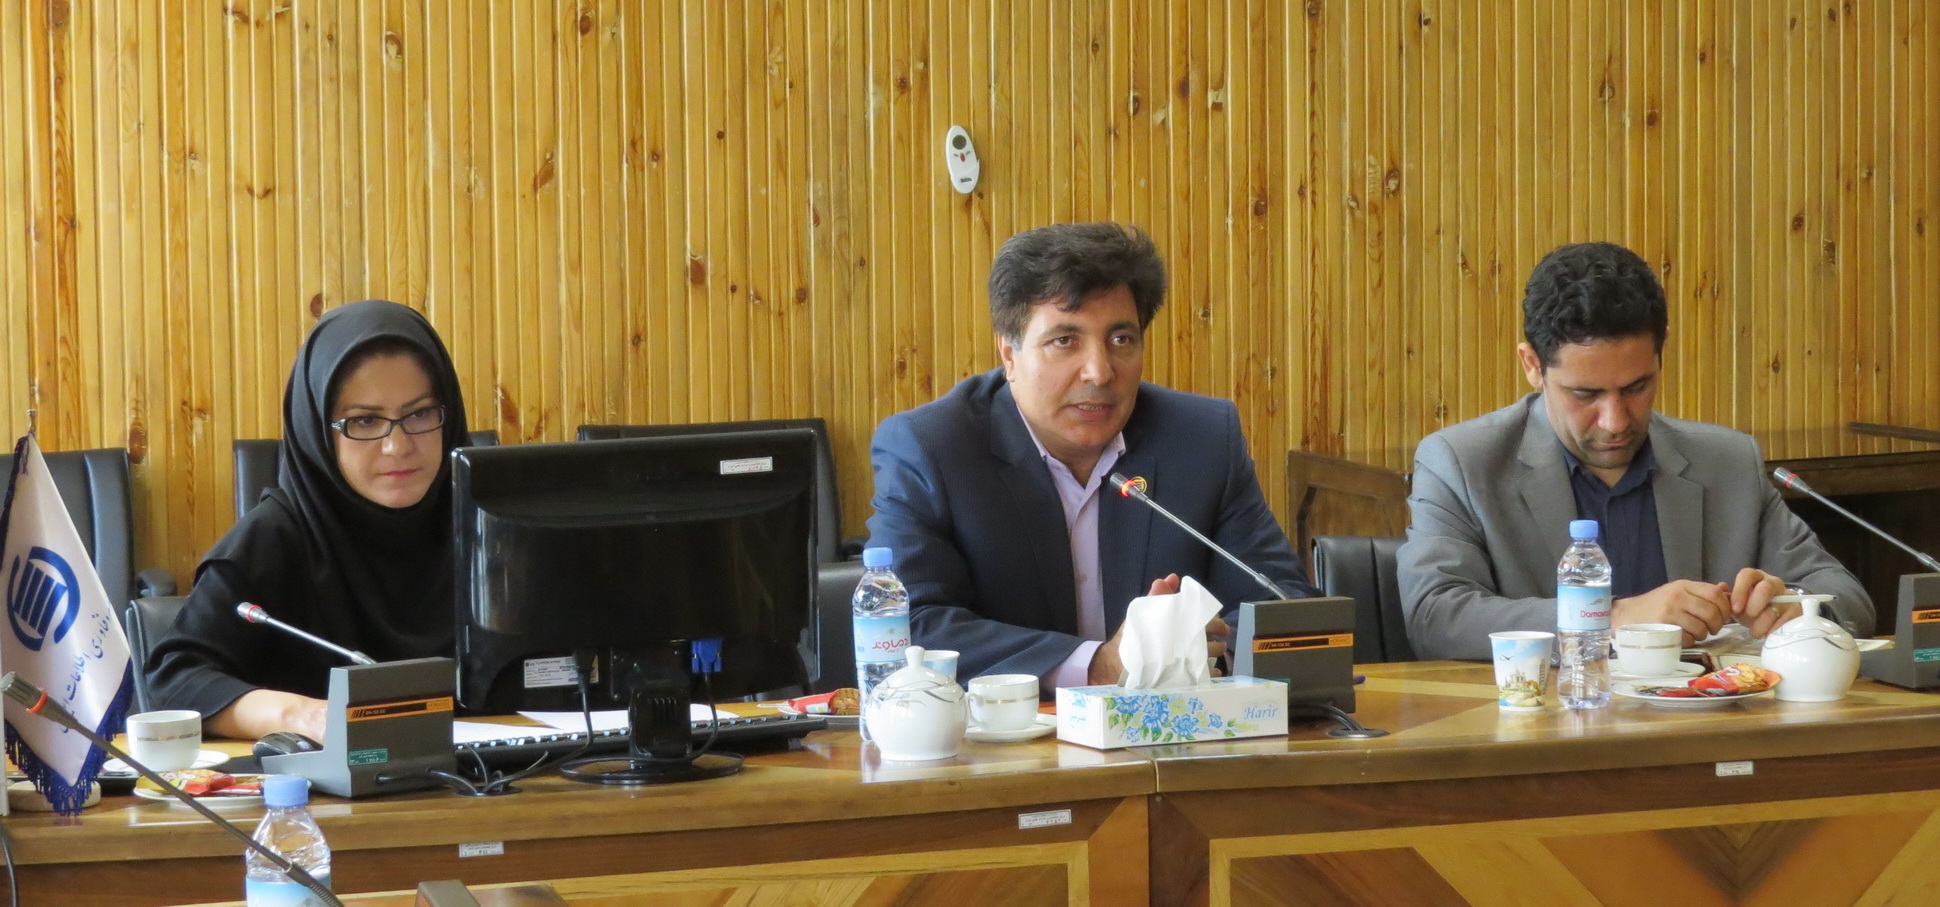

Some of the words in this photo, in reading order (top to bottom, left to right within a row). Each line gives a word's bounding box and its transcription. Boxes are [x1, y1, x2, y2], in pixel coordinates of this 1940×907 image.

[1580, 610, 1611, 618] Damava
[872, 638, 909, 651] دماوند
[66, 652, 91, 701] اطلاعات
[1243, 703, 1279, 720] Harir
